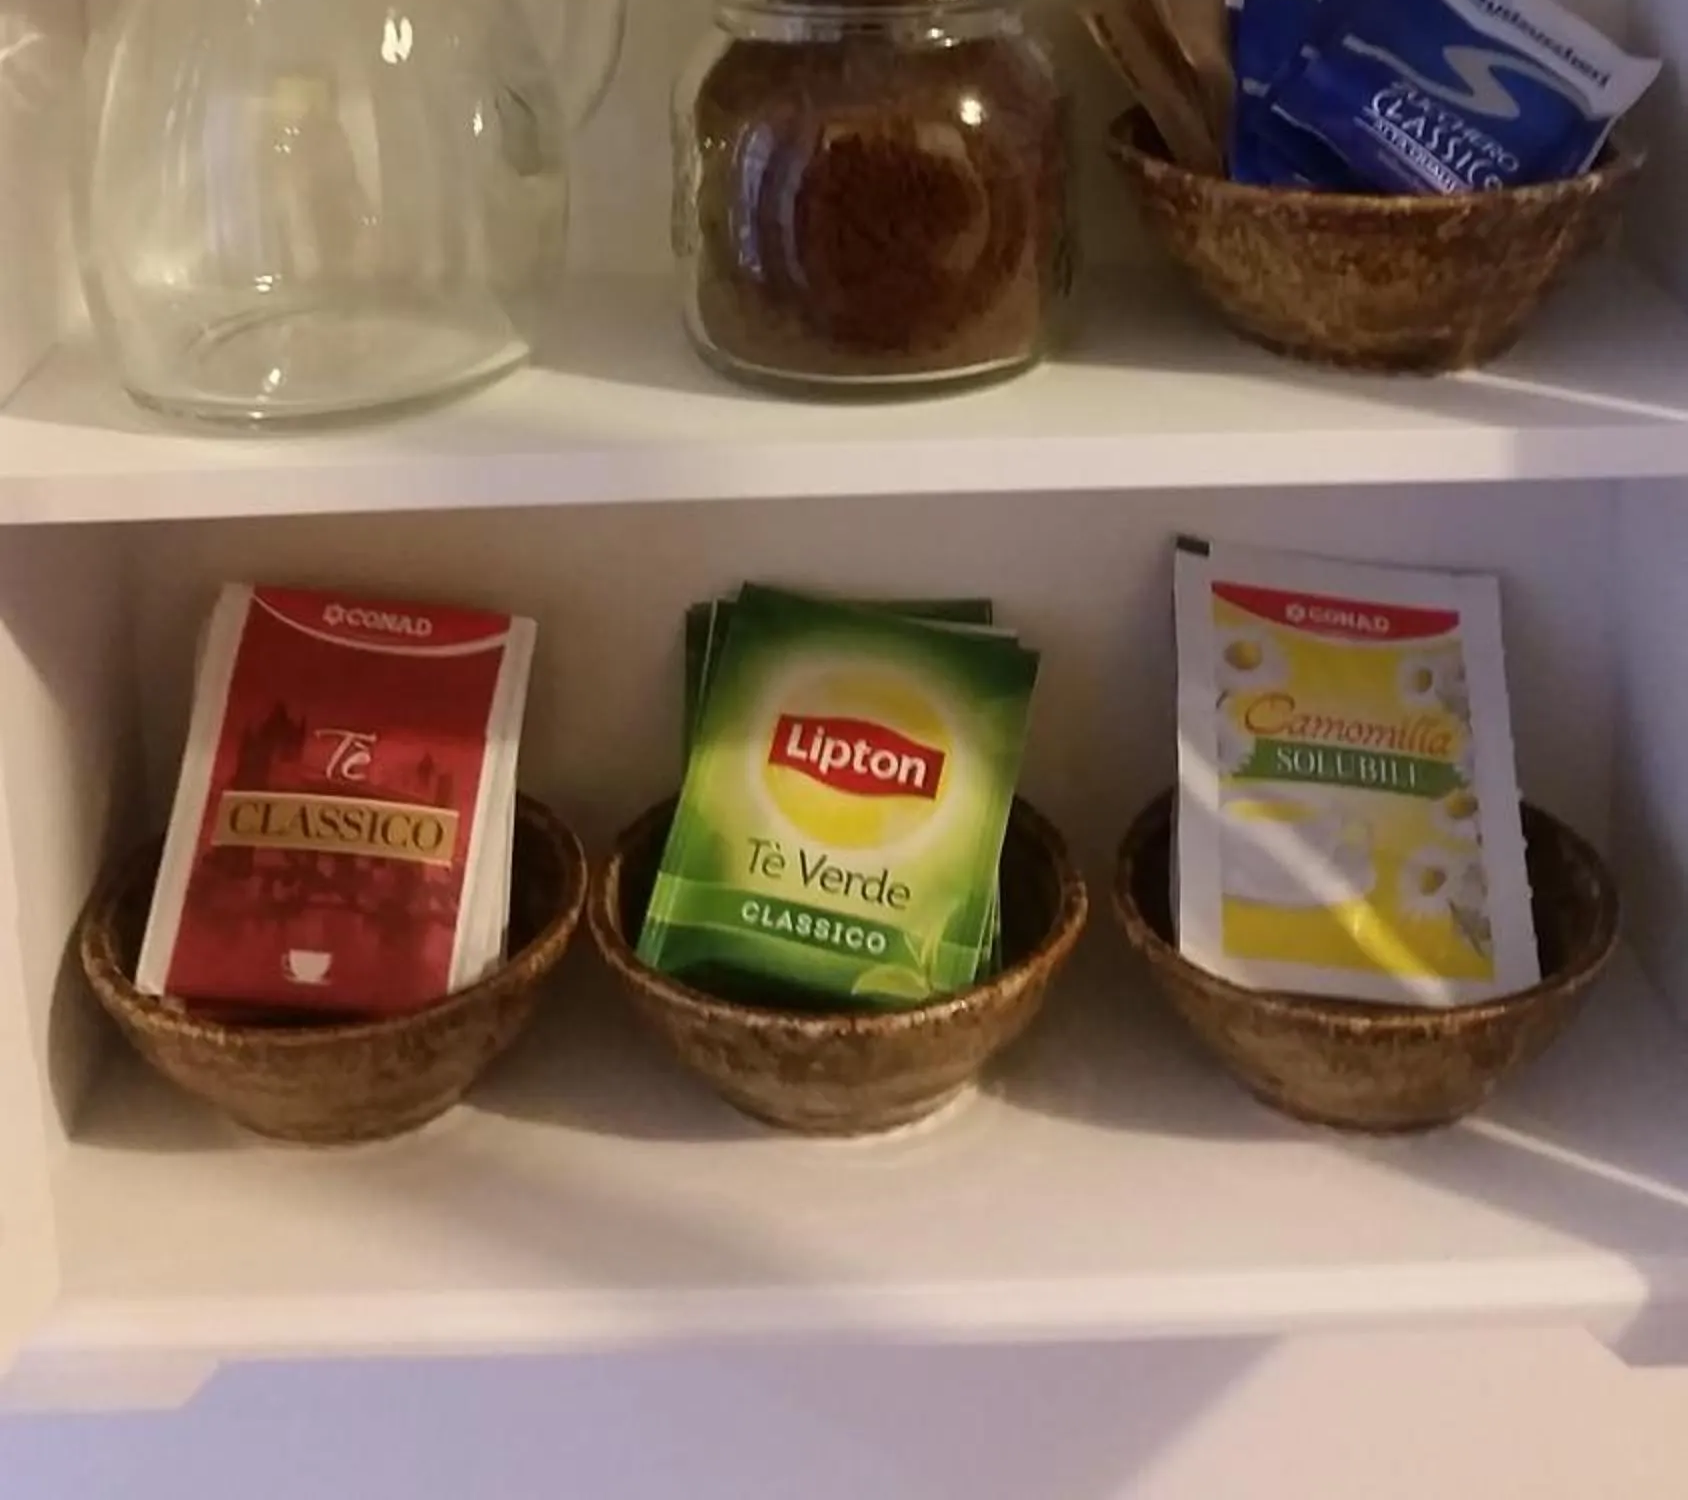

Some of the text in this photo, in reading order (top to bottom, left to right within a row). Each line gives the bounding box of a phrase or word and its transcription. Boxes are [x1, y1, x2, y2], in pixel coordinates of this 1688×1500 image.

[1371, 88, 1502, 190] CLASSICO
[346, 608, 433, 637] CONAD
[1308, 606, 1391, 635] CONAD
[1244, 694, 1452, 755] Camomilla
[315, 729, 377, 781] Tè
[785, 722, 928, 789] Lipton
[228, 802, 444, 852] CLASSICO
[746, 837, 911, 910] Tè Verde
[742, 900, 888, 955] CLASSICO
